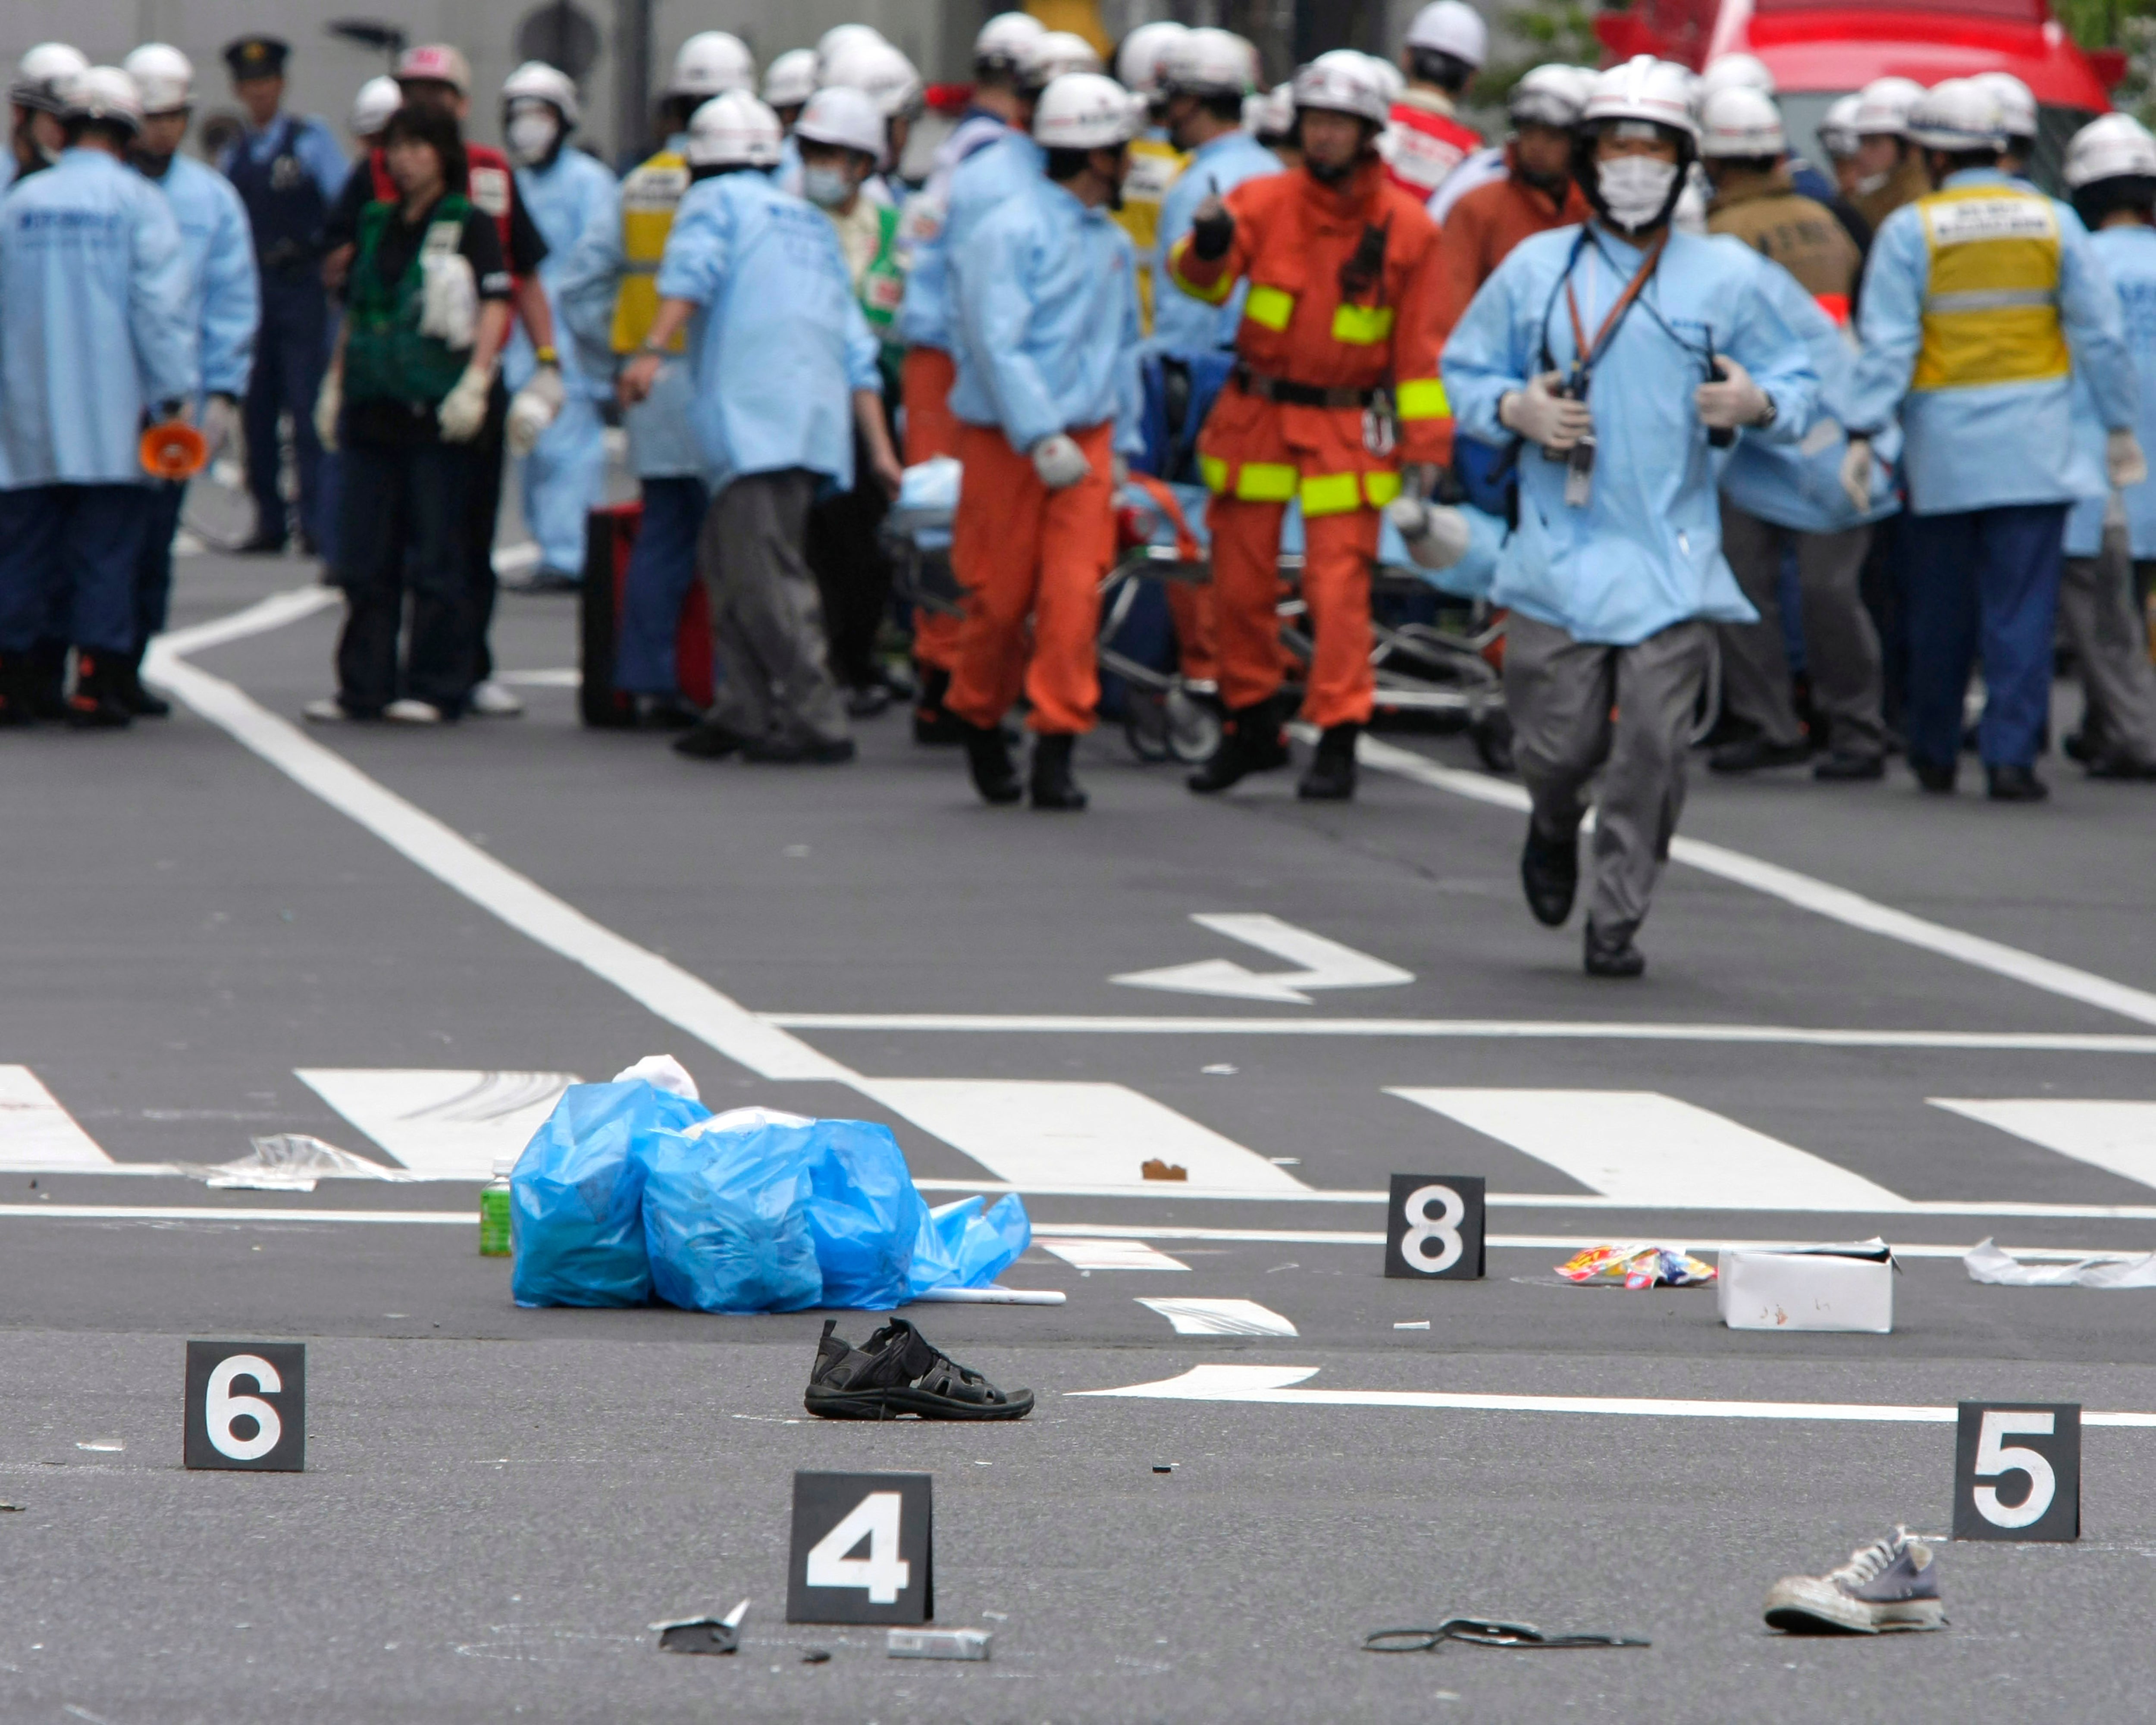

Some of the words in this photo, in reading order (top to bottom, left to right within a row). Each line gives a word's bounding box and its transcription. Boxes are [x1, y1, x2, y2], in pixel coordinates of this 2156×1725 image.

[1402, 1185, 1464, 1273] 8
[206, 1355, 281, 1460] 6
[1974, 1411, 2056, 1528] 5
[807, 1492, 909, 1603] 4
